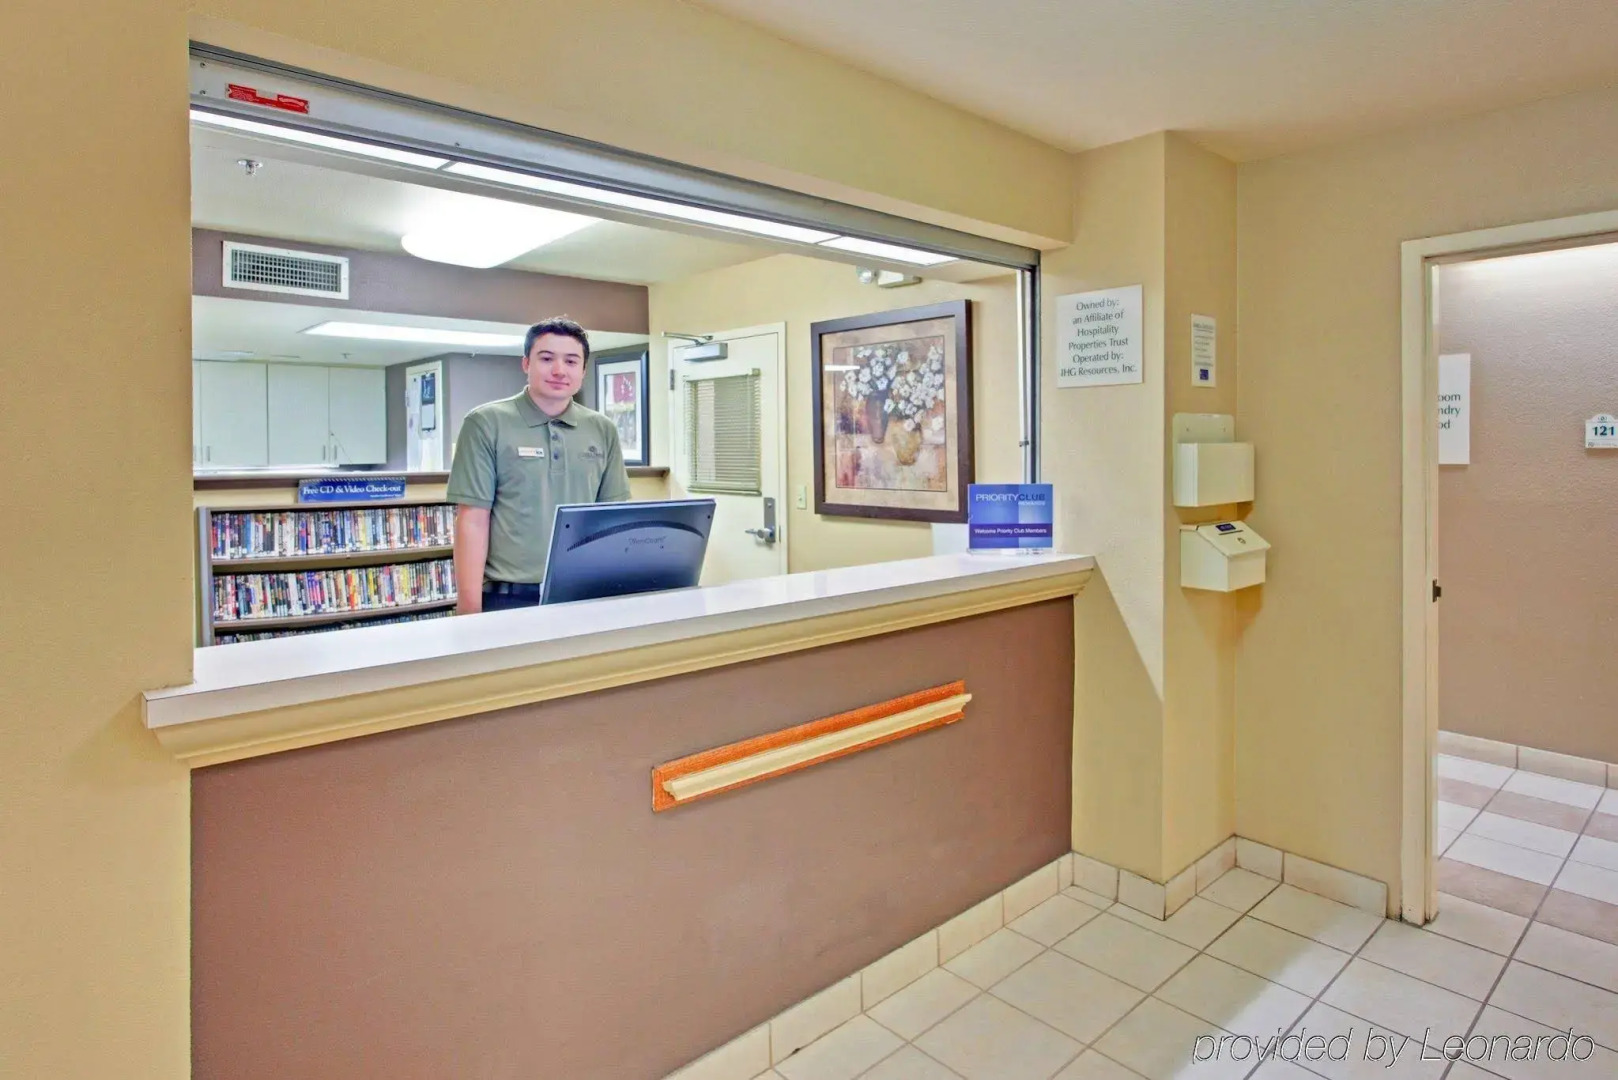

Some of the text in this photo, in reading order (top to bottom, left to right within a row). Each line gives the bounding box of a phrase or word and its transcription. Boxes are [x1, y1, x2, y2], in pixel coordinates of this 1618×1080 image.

[1076, 298, 1119, 311] Owned by:
[1072, 308, 1125, 325] an Affiliate of
[1077, 325, 1119, 338] Hospitality
[1068, 337, 1128, 352] Properties Trust
[1072, 351, 1124, 365] Operated by:
[1060, 364, 1137, 377] IHG Resources, Inc.
[1437, 393, 1461, 402] oom
[1437, 404, 1461, 418] ndry
[1438, 419, 1451, 429] od
[1592, 425, 1615, 436] 121
[303, 484, 402, 495] Free CD & Video Check-out
